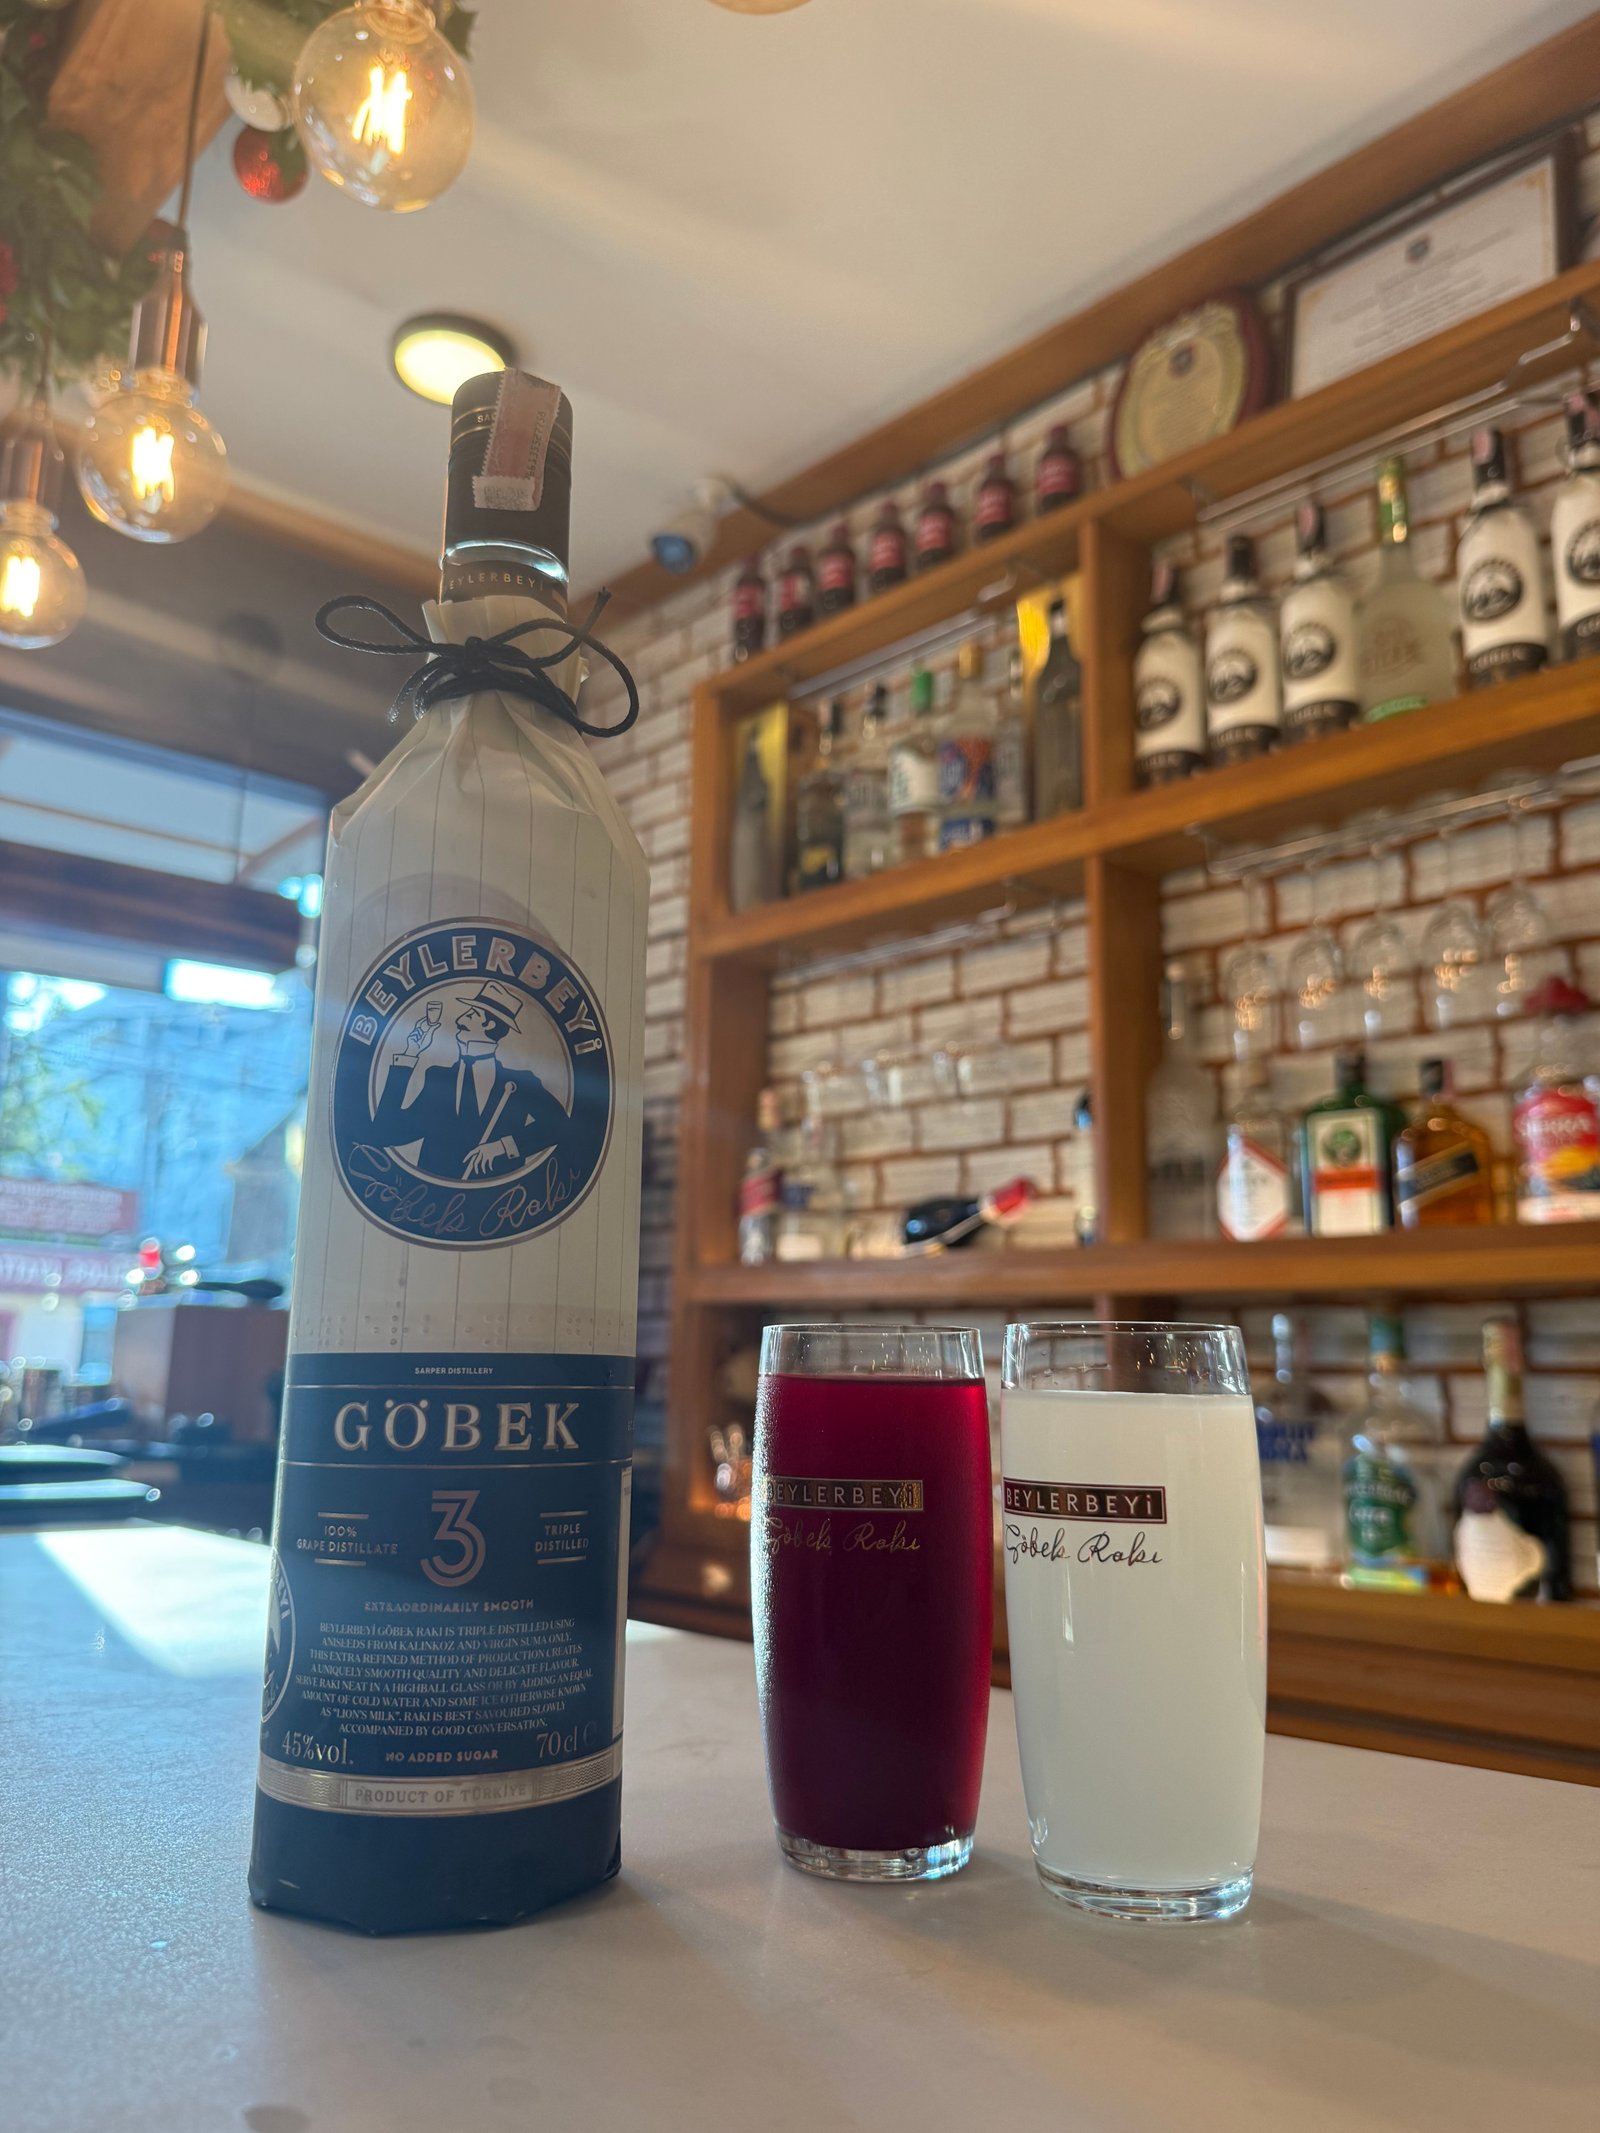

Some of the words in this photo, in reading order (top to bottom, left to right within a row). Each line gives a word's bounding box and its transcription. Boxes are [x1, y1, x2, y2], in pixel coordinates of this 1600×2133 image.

[414, 1366, 446, 1375] SARPER
[448, 1366, 494, 1375] DISTILLERY
[334, 1398, 580, 1453] GÖBEK
[324, 1525, 357, 1537] 100%
[419, 1489, 487, 1588] 3
[543, 1523, 581, 1537] TRIPLE
[296, 1538, 325, 1551] GRAPE
[328, 1541, 399, 1555] DISTILLATE
[534, 1538, 589, 1553] DISTILLED
[364, 1601, 480, 1614] EXTRAORDINARILY
[483, 1599, 534, 1612] SMOOTH
[377, 1624, 414, 1637] GÖBEK
[416, 1626, 443, 1637] RAKI
[445, 1626, 455, 1637] IS
[457, 1625, 496, 1636] TRIPLE
[498, 1620, 549, 1635] DISTILLED
[550, 1617, 575, 1630] USING
[322, 1637, 366, 1649] ANISEEDS
[367, 1639, 398, 1651] FROM
[399, 1640, 455, 1651] KALINKOZ
[456, 1639, 481, 1650] AND
[482, 1637, 519, 1649] VIRGIN
[520, 1634, 547, 1646] SUMA
[548, 1631, 572, 1643] ONLY.
[309, 1648, 328, 1660] THIS
[329, 1651, 361, 1663] EXTRA
[362, 1653, 409, 1665] REFINED
[410, 1654, 459, 1665] METHOD
[461, 1654, 477, 1664] OF
[478, 1649, 545, 1664] PRODUCTION
[546, 1643, 583, 1658] CREATES
[318, 1664, 363, 1677] UNIQUELY
[364, 1667, 411, 1679] SMOOTH
[412, 1668, 461, 1681] QUALITY
[463, 1667, 487, 1678] AND
[489, 1663, 539, 1677] DELICATE
[540, 1658, 579, 1672] FLAVOUR.
[295, 1673, 318, 1687] SERVE
[319, 1677, 340, 1690] RAKI
[341, 1680, 368, 1692] NEAT
[369, 1681, 381, 1692] IN
[382, 1681, 391, 1693] A
[392, 1682, 449, 1693] HIGHBALL
[450, 1681, 486, 1693] GLASS
[487, 1680, 503, 1691] OR
[504, 1679, 518, 1690] BY
[519, 1675, 556, 1688] ADDING
[557, 1672, 568, 1684] AN
[569, 1667, 593, 1682] EQUAL
[302, 1689, 336, 1703] AMOUNT
[337, 1693, 351, 1705] OF
[352, 1695, 381, 1706] COLD
[382, 1696, 420, 1708] WATER
[422, 1697, 447, 1708] AND
[448, 1696, 479, 1707] SOME
[481, 1694, 499, 1706] ICE
[500, 1688, 558, 1705] OTHERWISE
[559, 1683, 587, 1698] KNOWN
[320, 1706, 332, 1717] AS
[404, 1711, 430, 1722] RAKI
[432, 1711, 443, 1722] IS
[444, 1710, 475, 1722] BEST
[476, 1705, 530, 1720] SAVOURED
[531, 1700, 567, 1715] SLOWLY
[338, 1722, 414, 1736] ACCOMPANIED
[415, 1725, 430, 1736] BY
[431, 1725, 465, 1736] GOOD
[466, 1718, 548, 1734] CONVERSATION.
[385, 1752, 405, 1763] NO
[408, 1752, 453, 1763] ADDED
[456, 1749, 499, 1762] SUGAR
[355, 1787, 431, 1804] PRODUCT
[434, 1790, 455, 1803] OF
